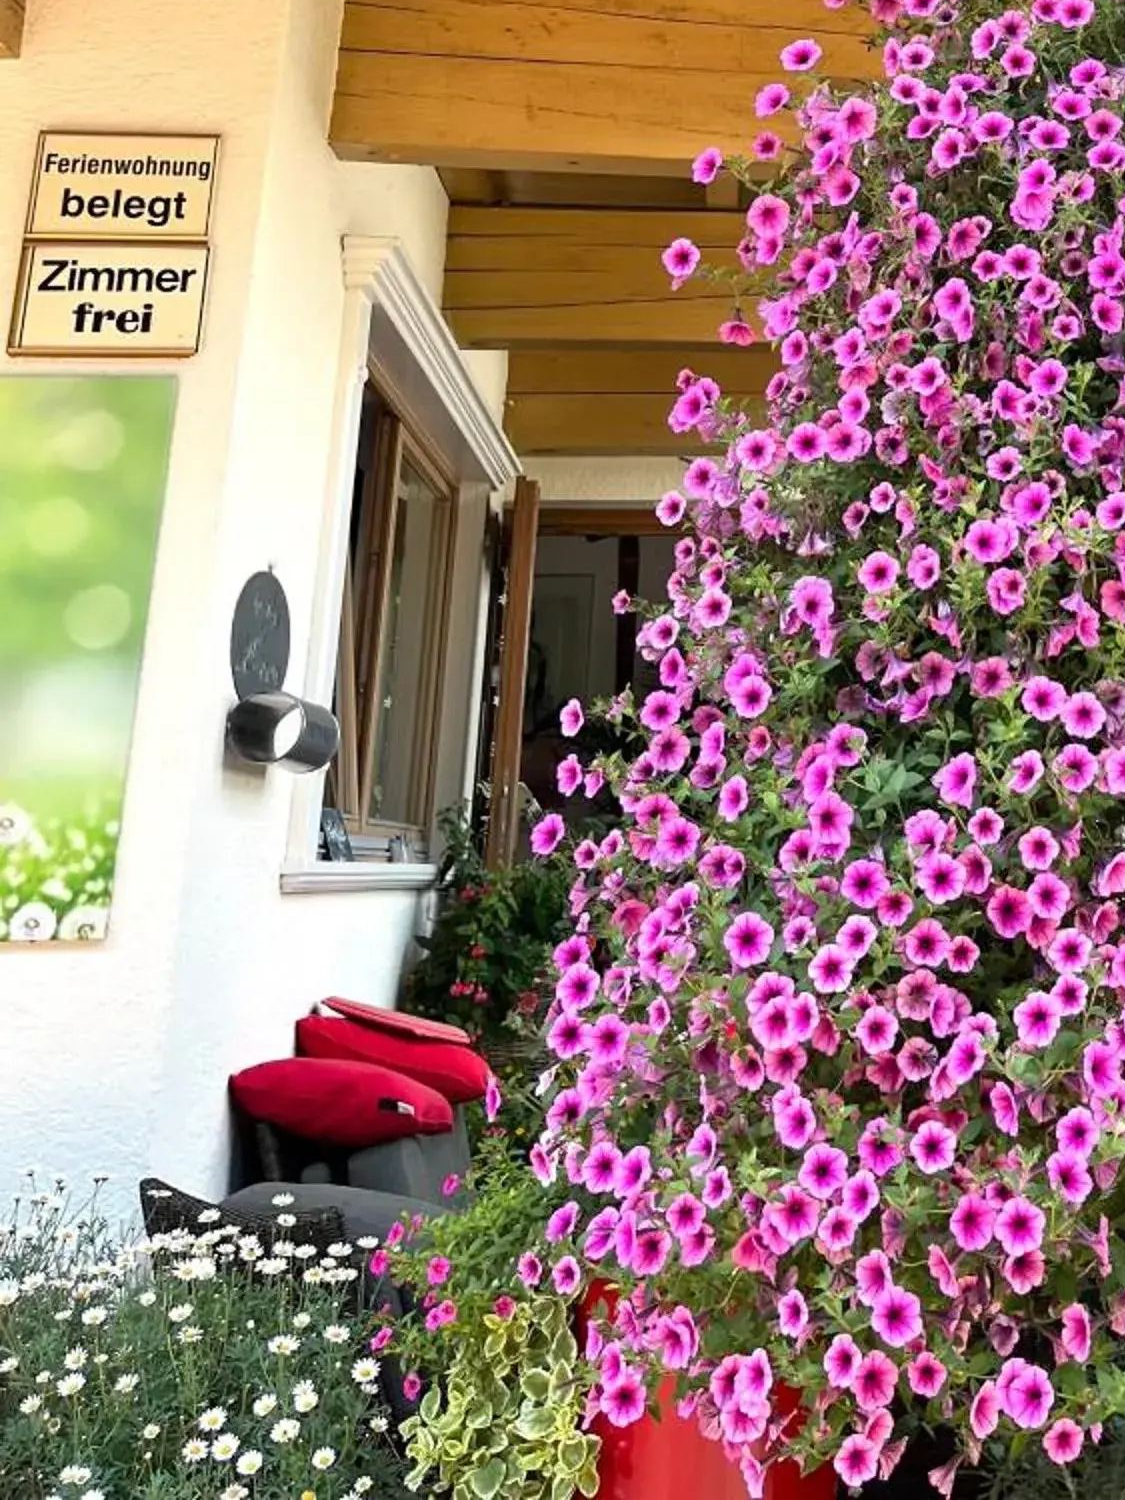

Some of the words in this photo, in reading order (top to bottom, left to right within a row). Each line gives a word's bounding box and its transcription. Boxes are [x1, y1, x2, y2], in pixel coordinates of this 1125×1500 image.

[44, 153, 211, 181] Ferienwohnung
[61, 188, 187, 227] belegt
[38, 260, 197, 292] Zimmer
[72, 302, 154, 333] frei
